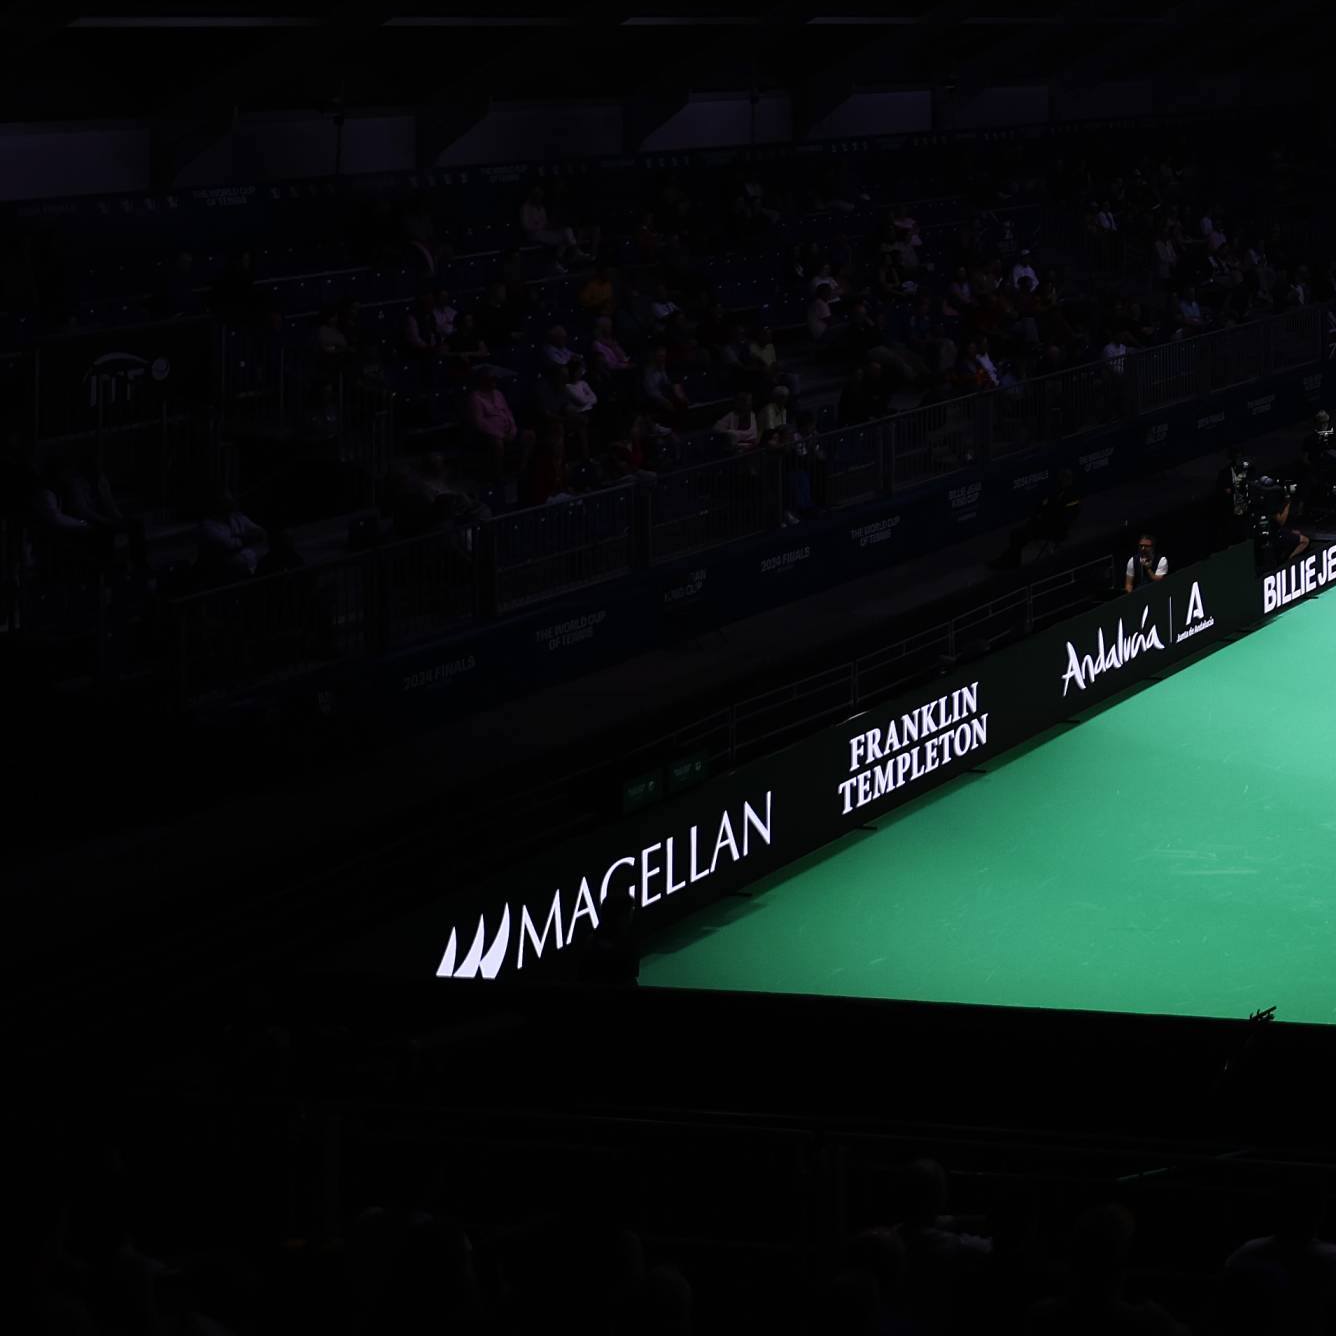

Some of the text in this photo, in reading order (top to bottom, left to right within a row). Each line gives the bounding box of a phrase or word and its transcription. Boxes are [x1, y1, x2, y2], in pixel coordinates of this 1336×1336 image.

[1264, 555, 1316, 614] BILLIE
[1062, 605, 1165, 696] Andalucía
[838, 714, 988, 815] TEMPLETON
[850, 682, 978, 771] FRANKLIN
[517, 791, 771, 970] MAGELLAN
